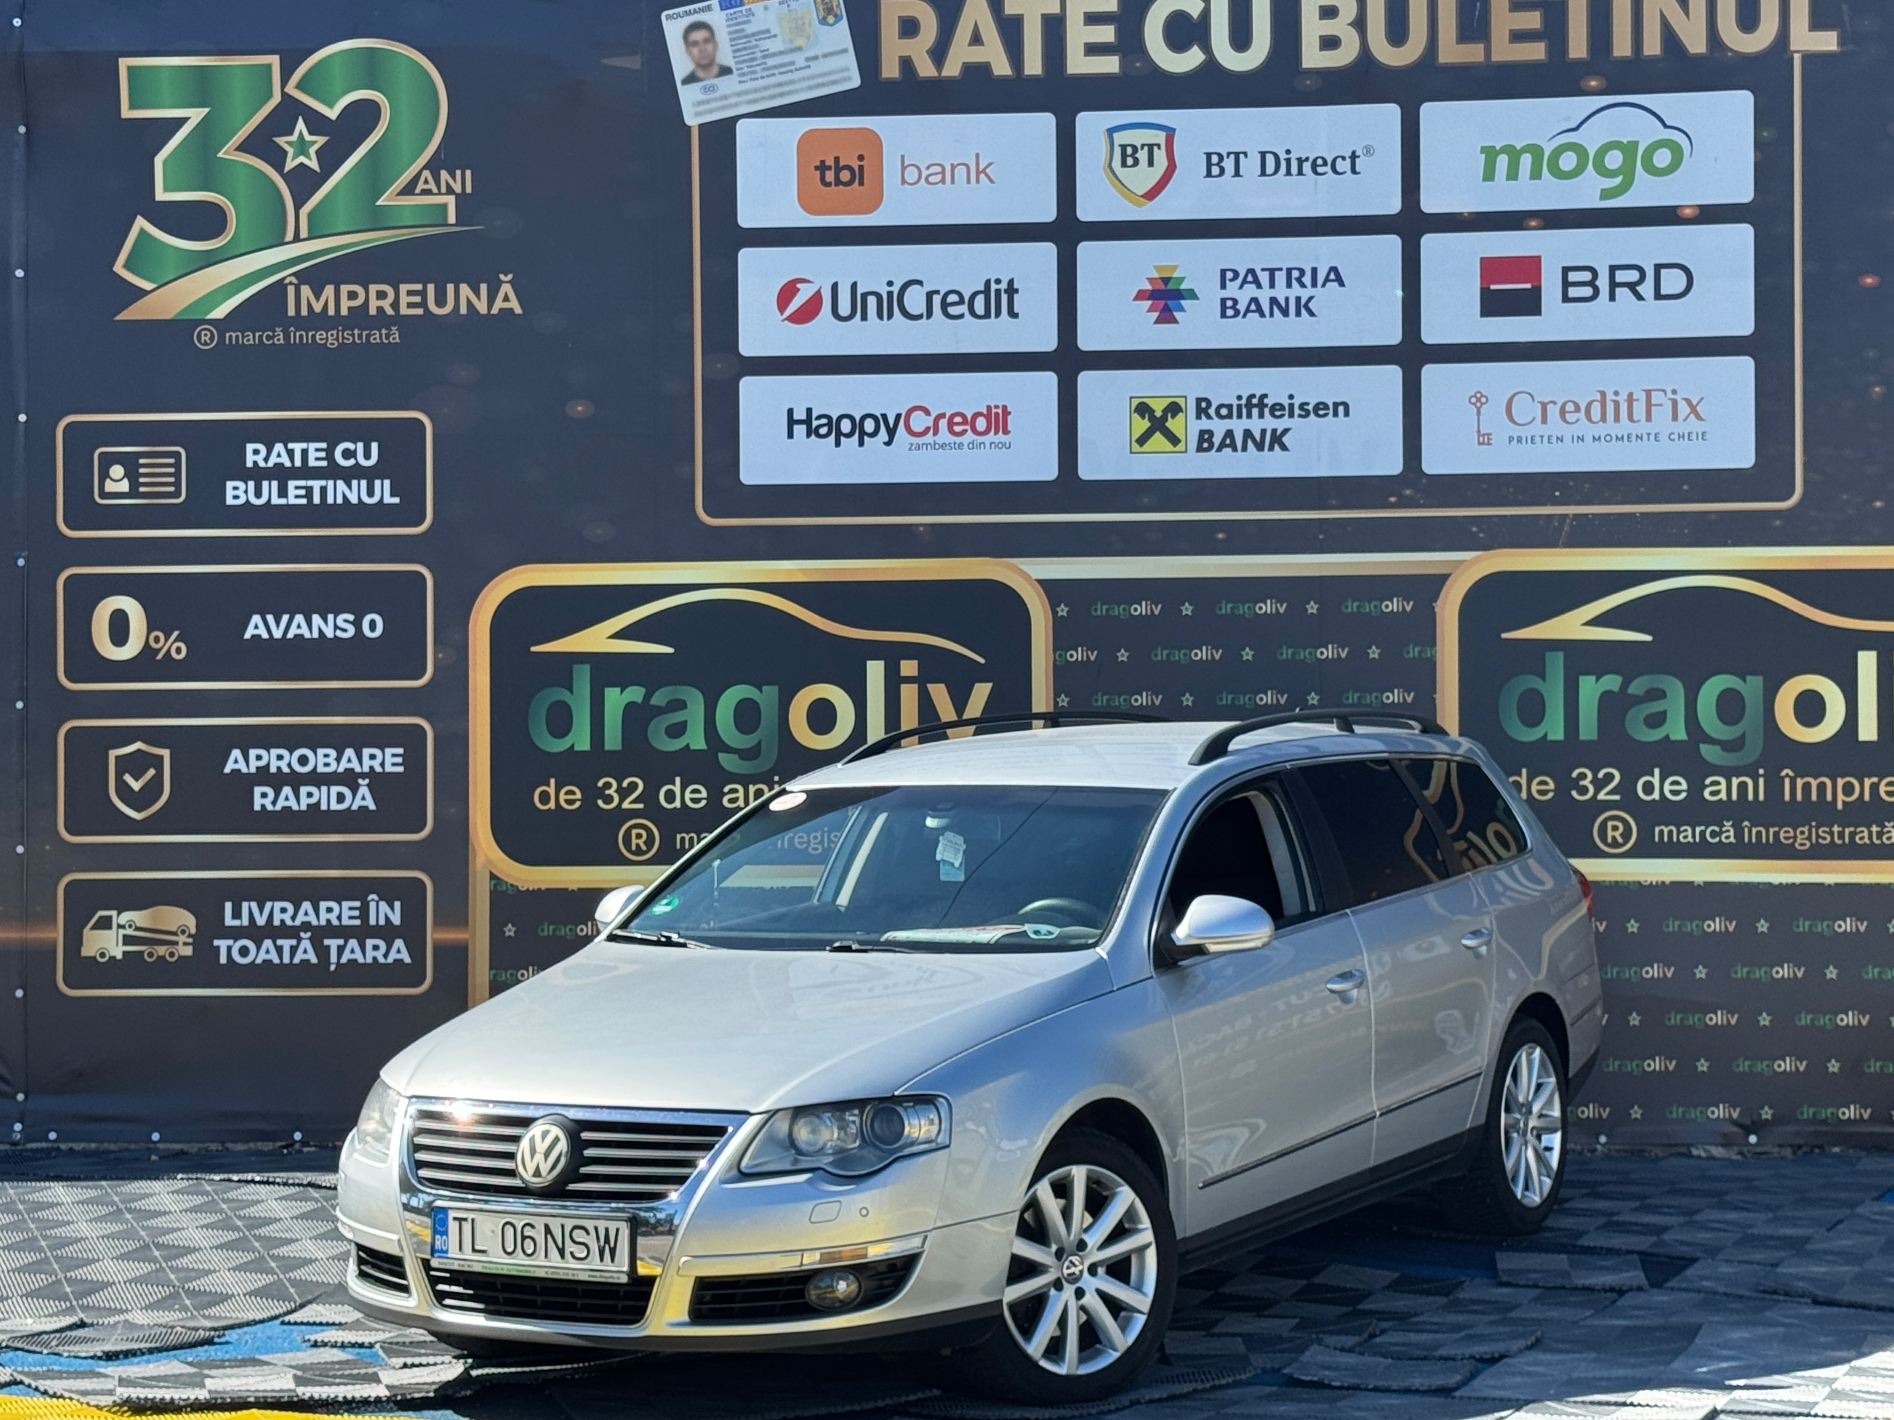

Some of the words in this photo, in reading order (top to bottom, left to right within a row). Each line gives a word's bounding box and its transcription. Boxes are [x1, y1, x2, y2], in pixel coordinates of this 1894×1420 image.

[879, 0, 1123, 80] RATE
[1143, 0, 1273, 75] CU
[1300, 0, 1840, 70] BULETINUL
[113, 38, 456, 291] 32
[414, 169, 472, 194] ANI
[900, 152, 996, 187] bank
[1118, 143, 1162, 169] BT
[1203, 151, 1248, 178] BT
[1479, 138, 1685, 201] mogo
[814, 154, 866, 189] tbi
[1219, 265, 1346, 290] PATRIA
[1560, 262, 1694, 303] BRD
[283, 273, 523, 318] ÎMPREUNĂ
[830, 277, 1019, 322] UniCredit
[1219, 295, 1317, 319] BANK
[225, 328, 285, 346] marcă
[290, 326, 400, 349] înregistrată
[1195, 393, 1350, 420] Raiffeisen
[1504, 388, 1706, 426] CreditFix
[786, 404, 1012, 448] HappyCredit
[1508, 434, 1564, 445] PRIETEN
[1571, 434, 1585, 444] IN
[1592, 432, 1661, 444] MOMENTE
[1668, 431, 1708, 442] CHEIE
[907, 440, 964, 452] zambeste
[967, 439, 986, 450] din
[989, 441, 1012, 450] nou
[1195, 428, 1293, 453] BANK
[245, 442, 328, 468] RATE
[334, 441, 379, 467] CU
[225, 478, 400, 505] BULETINUL
[1091, 600, 1162, 619] dragoliv
[1216, 599, 1287, 618] dragoliv
[1341, 597, 1414, 616] dragoliv
[243, 613, 356, 639] AVANS
[361, 613, 384, 639] 0
[1151, 646, 1222, 664] dragoliv
[1276, 644, 1348, 663] dragoliv
[1092, 691, 1162, 709] dragoliv
[1216, 690, 1288, 709] dragoliv
[1342, 688, 1414, 707] dragoliv
[1500, 650, 1894, 766] dragol
[528, 660, 993, 774] dragoliv
[223, 747, 404, 774] APROBARE
[252, 778, 376, 811] RAPIDĂ
[533, 777, 582, 810] de
[597, 776, 645, 810] 32
[659, 777, 708, 809] de
[1571, 767, 1621, 800] 32
[1636, 768, 1688, 801] de
[1703, 768, 1765, 800] ani
[1655, 820, 1736, 844] marcă
[1742, 819, 1894, 850] înregistrată
[224, 901, 361, 927] LIVRARE
[368, 894, 401, 926] ÎN
[538, 921, 599, 939] dragoli
[1662, 916, 1737, 935] dragoliv
[1792, 917, 1868, 936] dragoliv
[213, 932, 322, 965] TOATĂ
[324, 937, 411, 971] ȚARA
[1601, 963, 1675, 981] dragoliv
[1730, 963, 1805, 982] dragoliv
[1665, 1009, 1739, 1028] dragoliv
[1795, 1010, 1871, 1029] dragoliv
[1603, 1056, 1676, 1075] dragoliv
[1732, 1056, 1808, 1076] dragoliv
[1666, 1103, 1741, 1123] dragoliv
[1797, 1104, 1872, 1124] dragoliv
[435, 1235, 448, 1250] RO
[452, 1217, 488, 1254] TL
